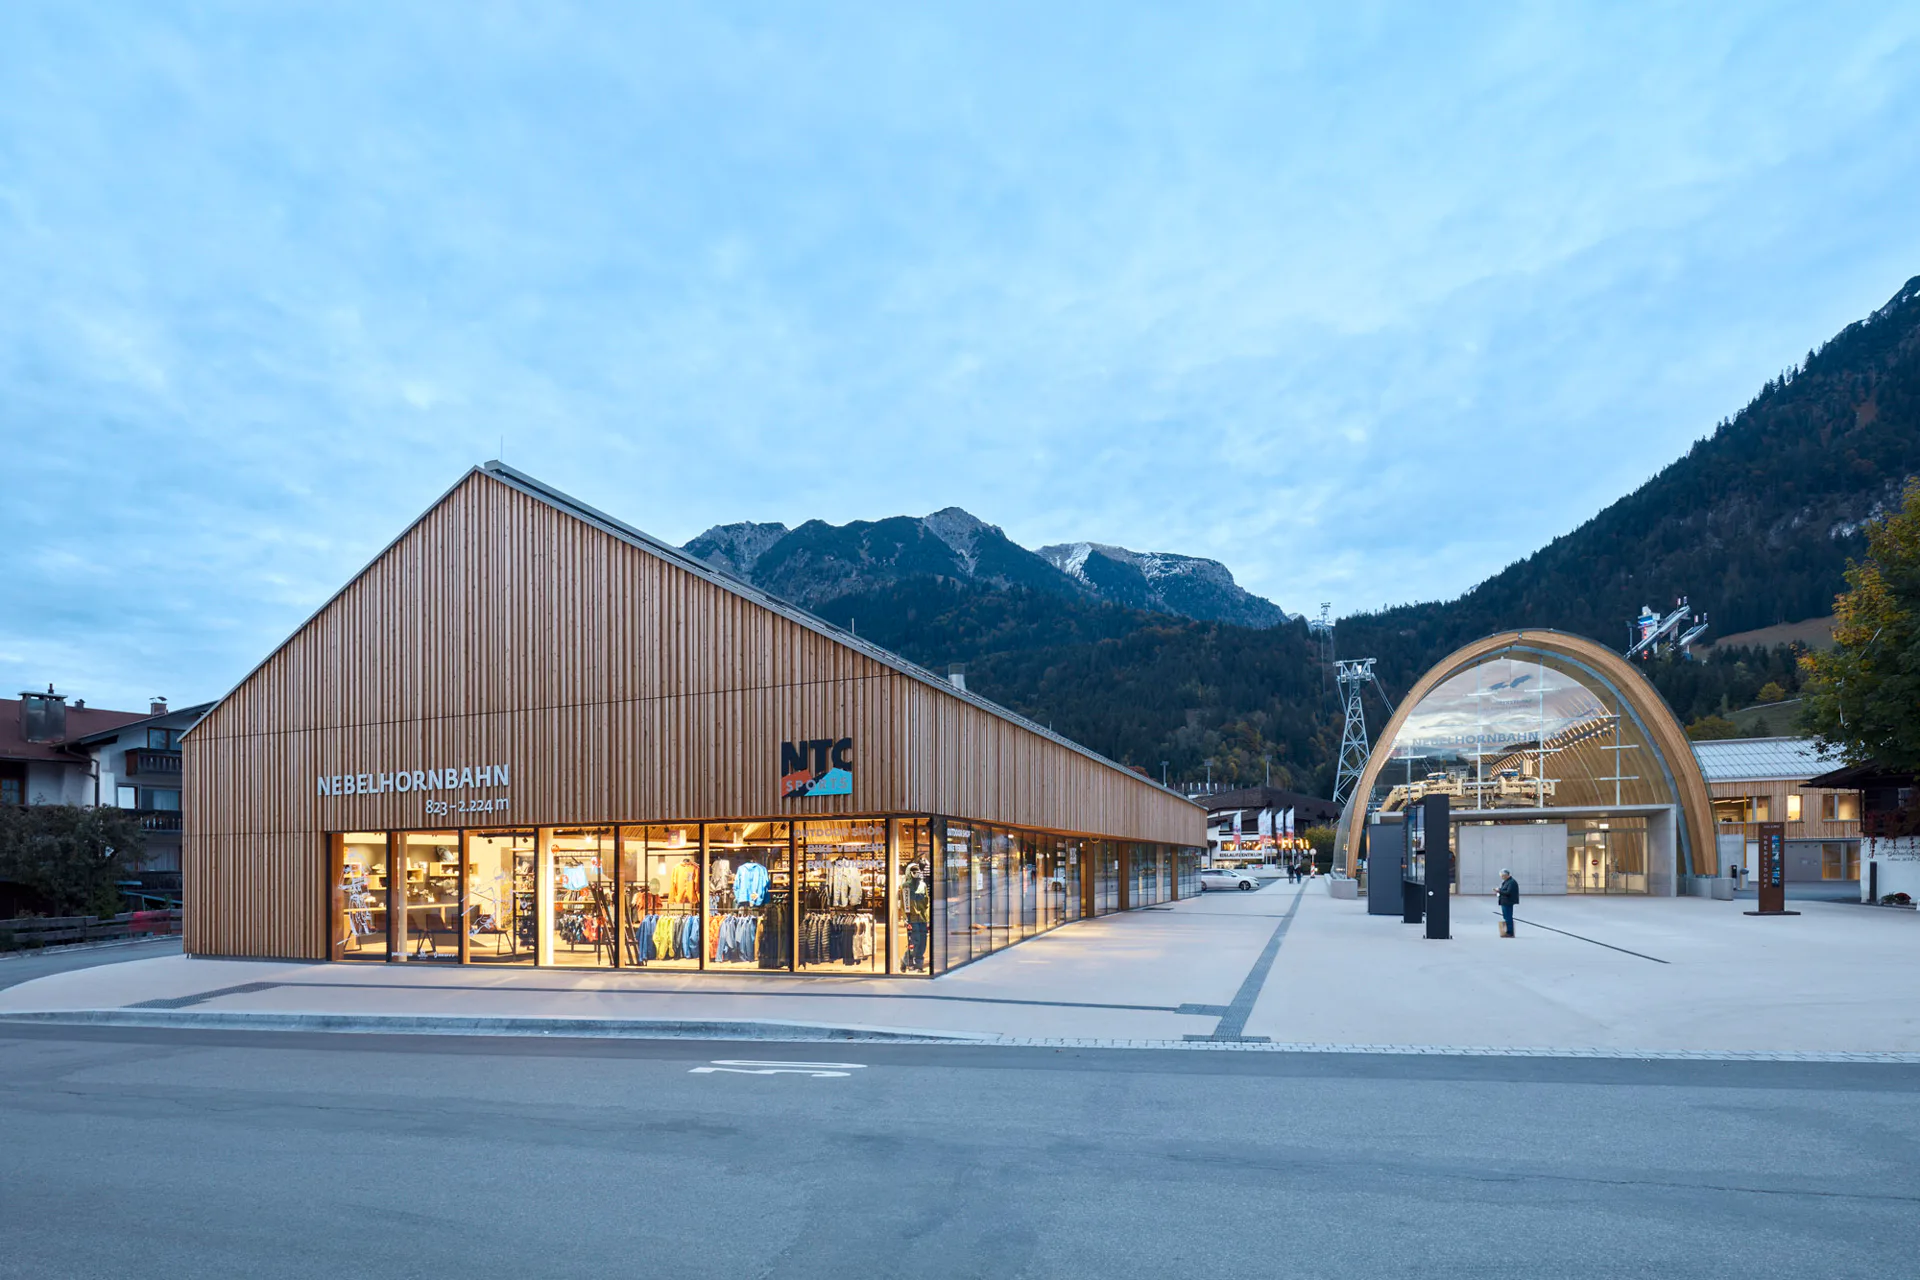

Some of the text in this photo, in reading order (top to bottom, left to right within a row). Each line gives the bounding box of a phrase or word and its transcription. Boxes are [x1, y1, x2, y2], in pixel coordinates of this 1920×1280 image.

[1412, 731, 1538, 747] NEBELHORNBAHN
[781, 737, 852, 777] NTC
[317, 764, 509, 796] NEBELHORNBAHN
[786, 777, 848, 792] SPORTS
[495, 797, 509, 811] m
[793, 826, 883, 838] OUTDOOR SHOP
[807, 842, 883, 853] BIKE VERLEIH
[807, 859, 884, 869] BIKE GUIDING
